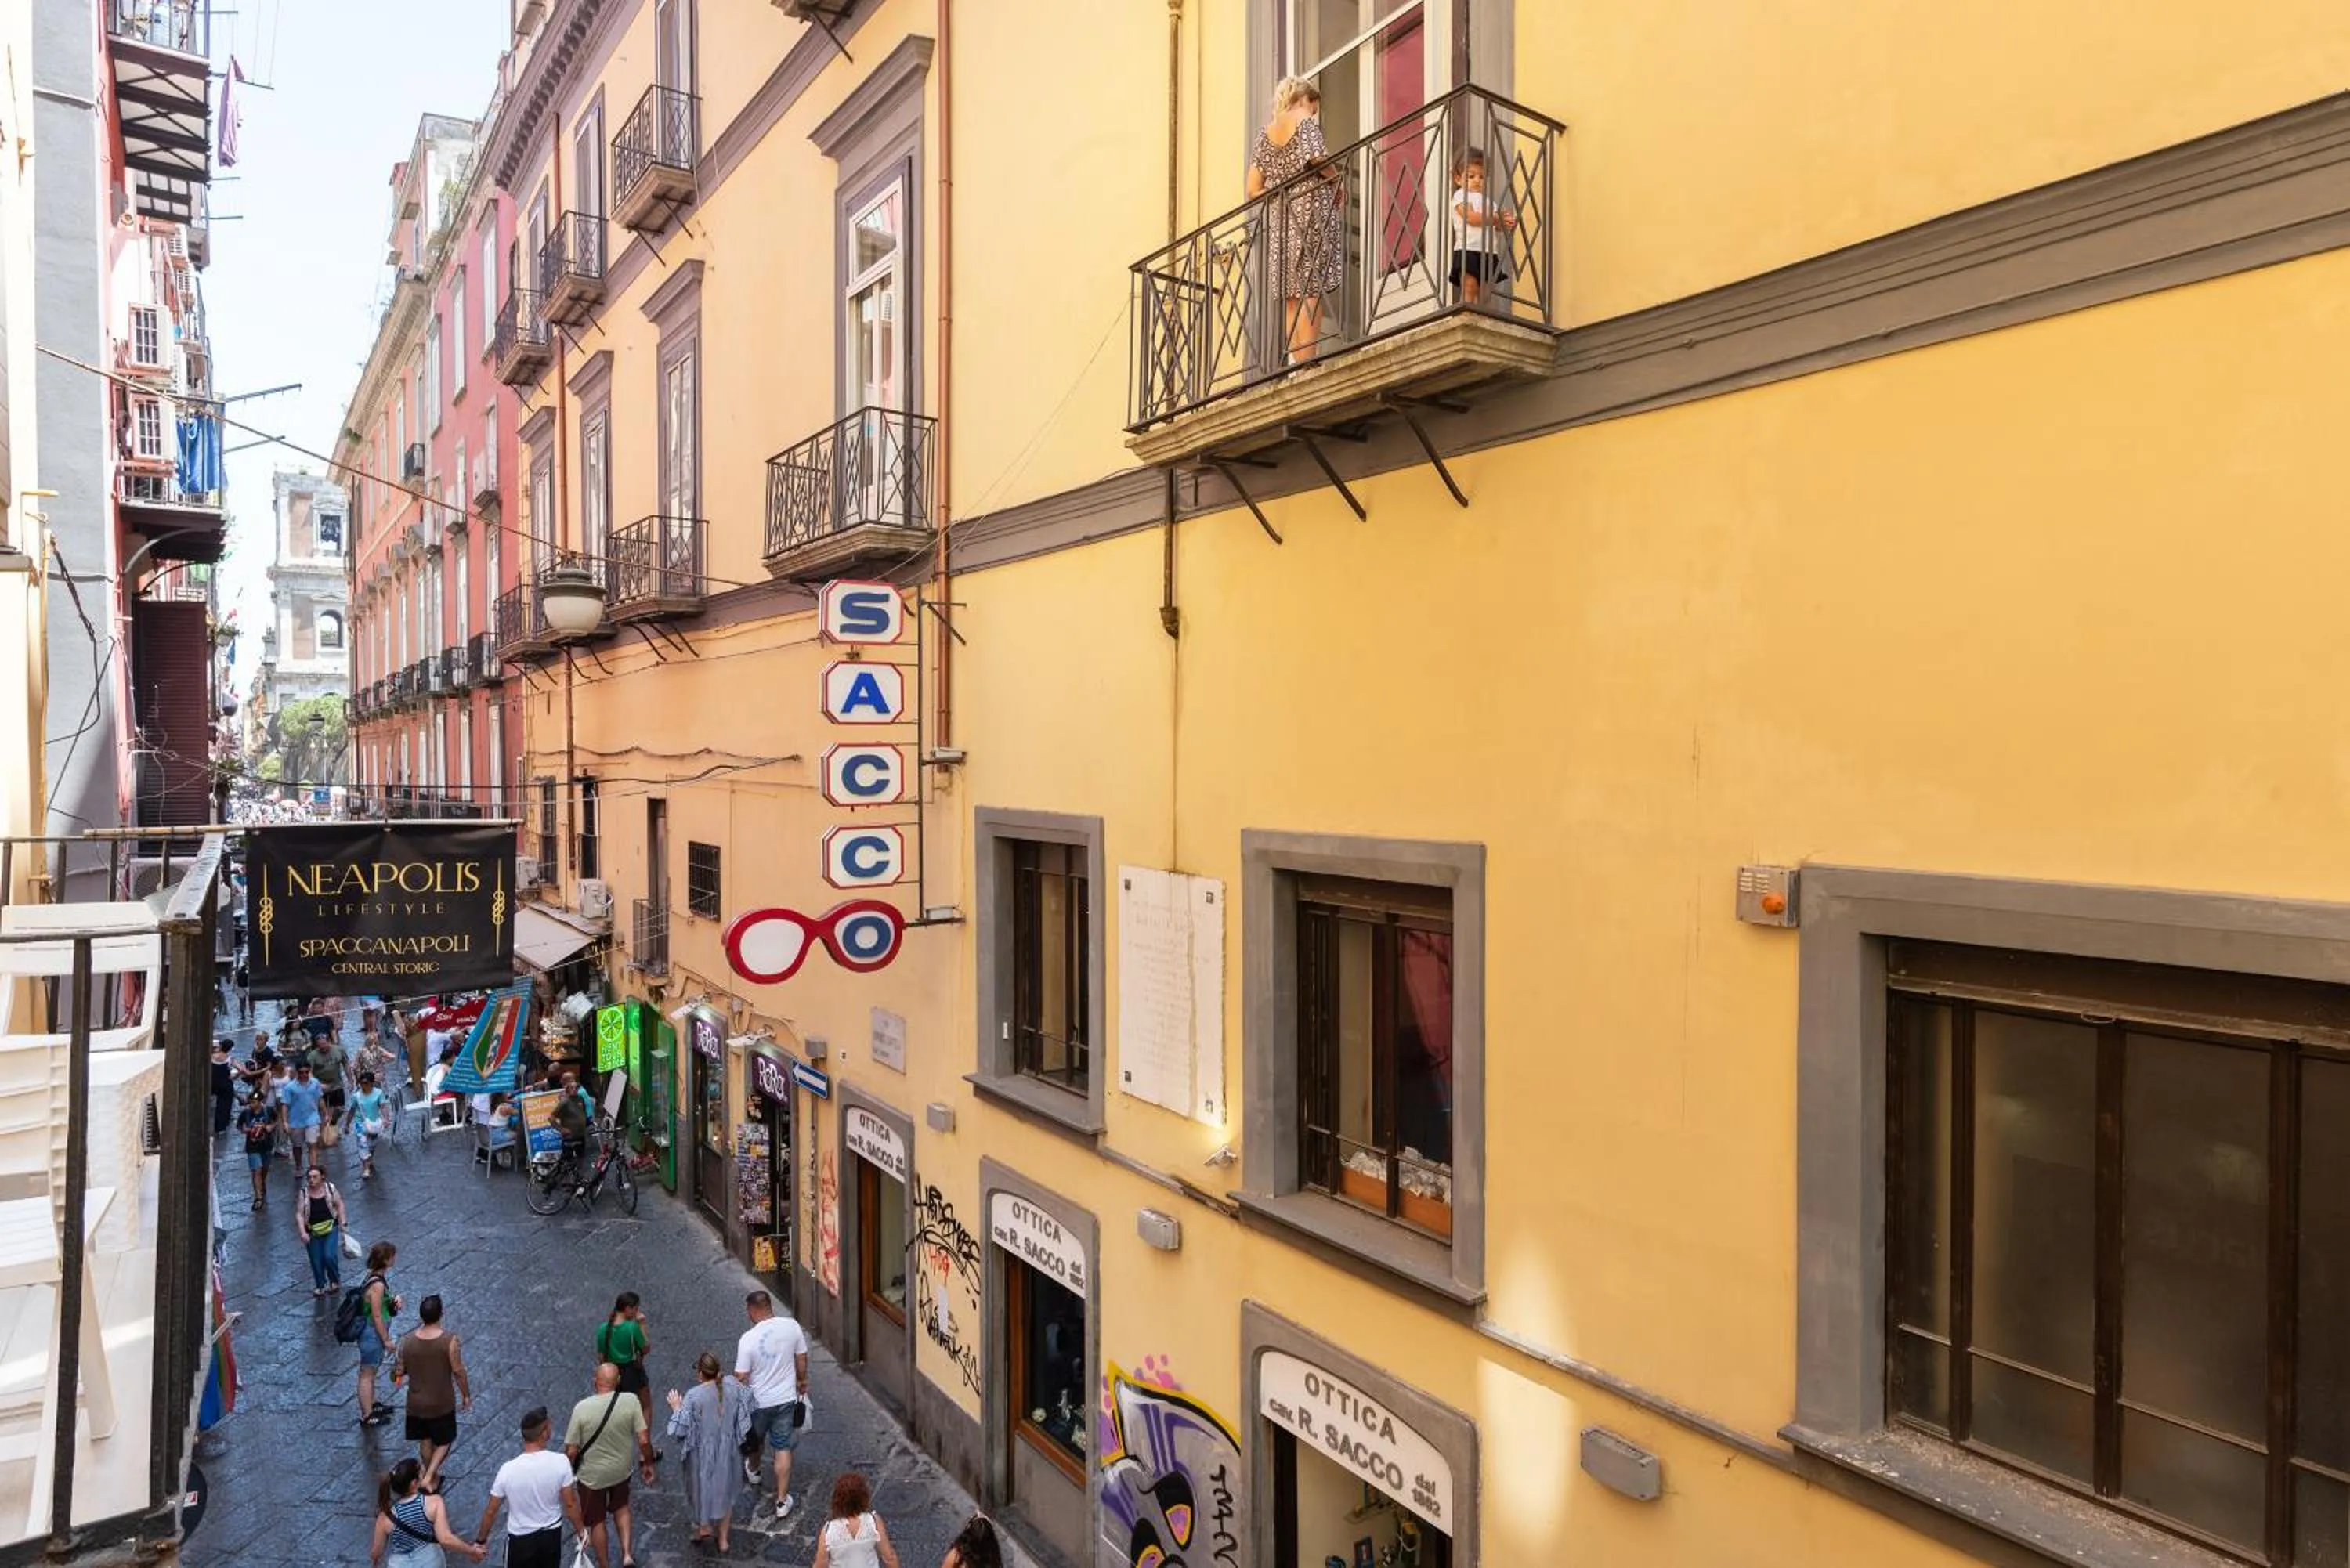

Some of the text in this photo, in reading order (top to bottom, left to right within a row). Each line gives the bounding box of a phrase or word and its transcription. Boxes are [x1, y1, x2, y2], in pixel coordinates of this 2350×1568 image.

[840, 591, 891, 958] SACCO
[287, 862, 481, 897] NEAPOLIS
[318, 902, 445, 916] LIFESTYLE
[299, 934, 470, 958] SPACCANAPOLI
[331, 963, 389, 974] CENTRAL
[859, 1113, 891, 1144] OTTICA
[1012, 1201, 1061, 1244] OTTICA
[1009, 1227, 1021, 1249] R.
[1024, 1237, 1065, 1277] SACCO
[1304, 1372, 1397, 1446] OTTICA
[1298, 1404, 1318, 1440] R.
[1325, 1423, 1404, 1491] SACCO
[1415, 1473, 1436, 1497] dal
